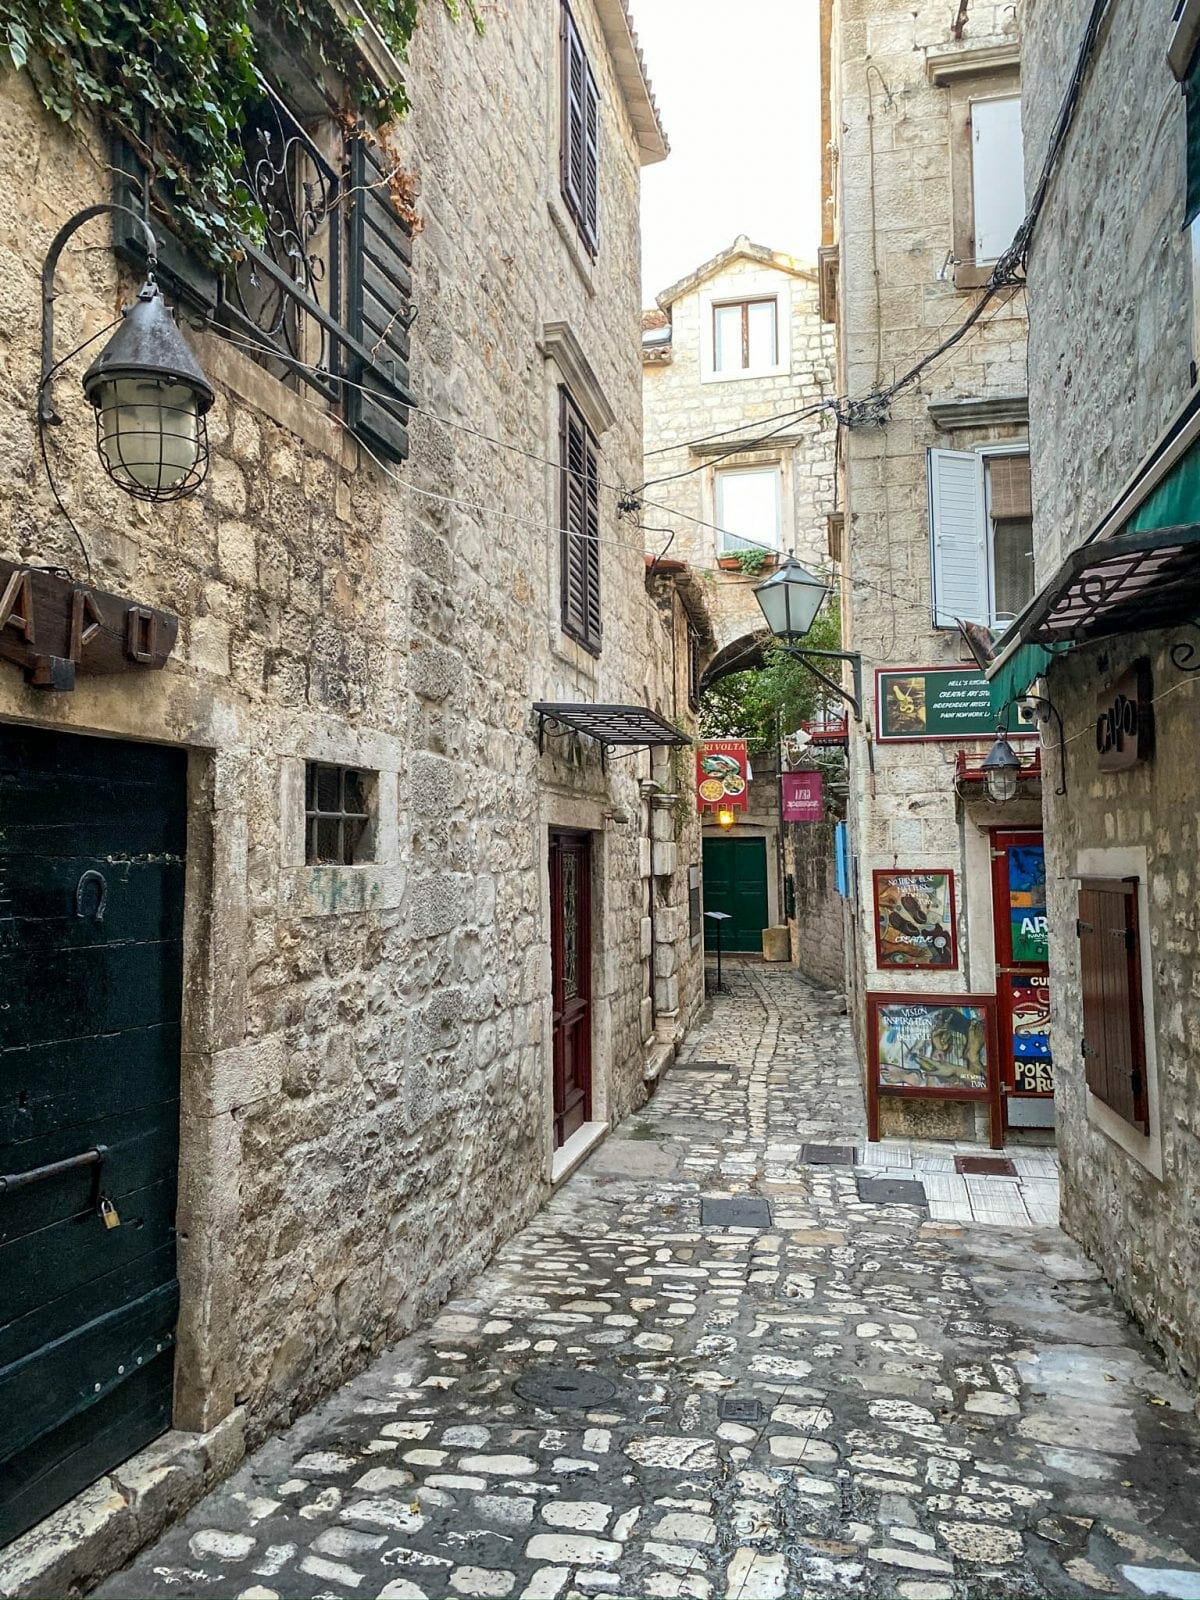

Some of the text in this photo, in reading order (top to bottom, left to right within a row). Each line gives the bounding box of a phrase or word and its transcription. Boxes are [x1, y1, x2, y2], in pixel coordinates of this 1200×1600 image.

[939, 690, 966, 698] CREATIVE
[932, 701, 970, 709] INDEPENDENT
[1096, 694, 1137, 754] CAPO
[704, 743, 745, 751] RIVOLTA
[901, 1007, 928, 1018] VISION
